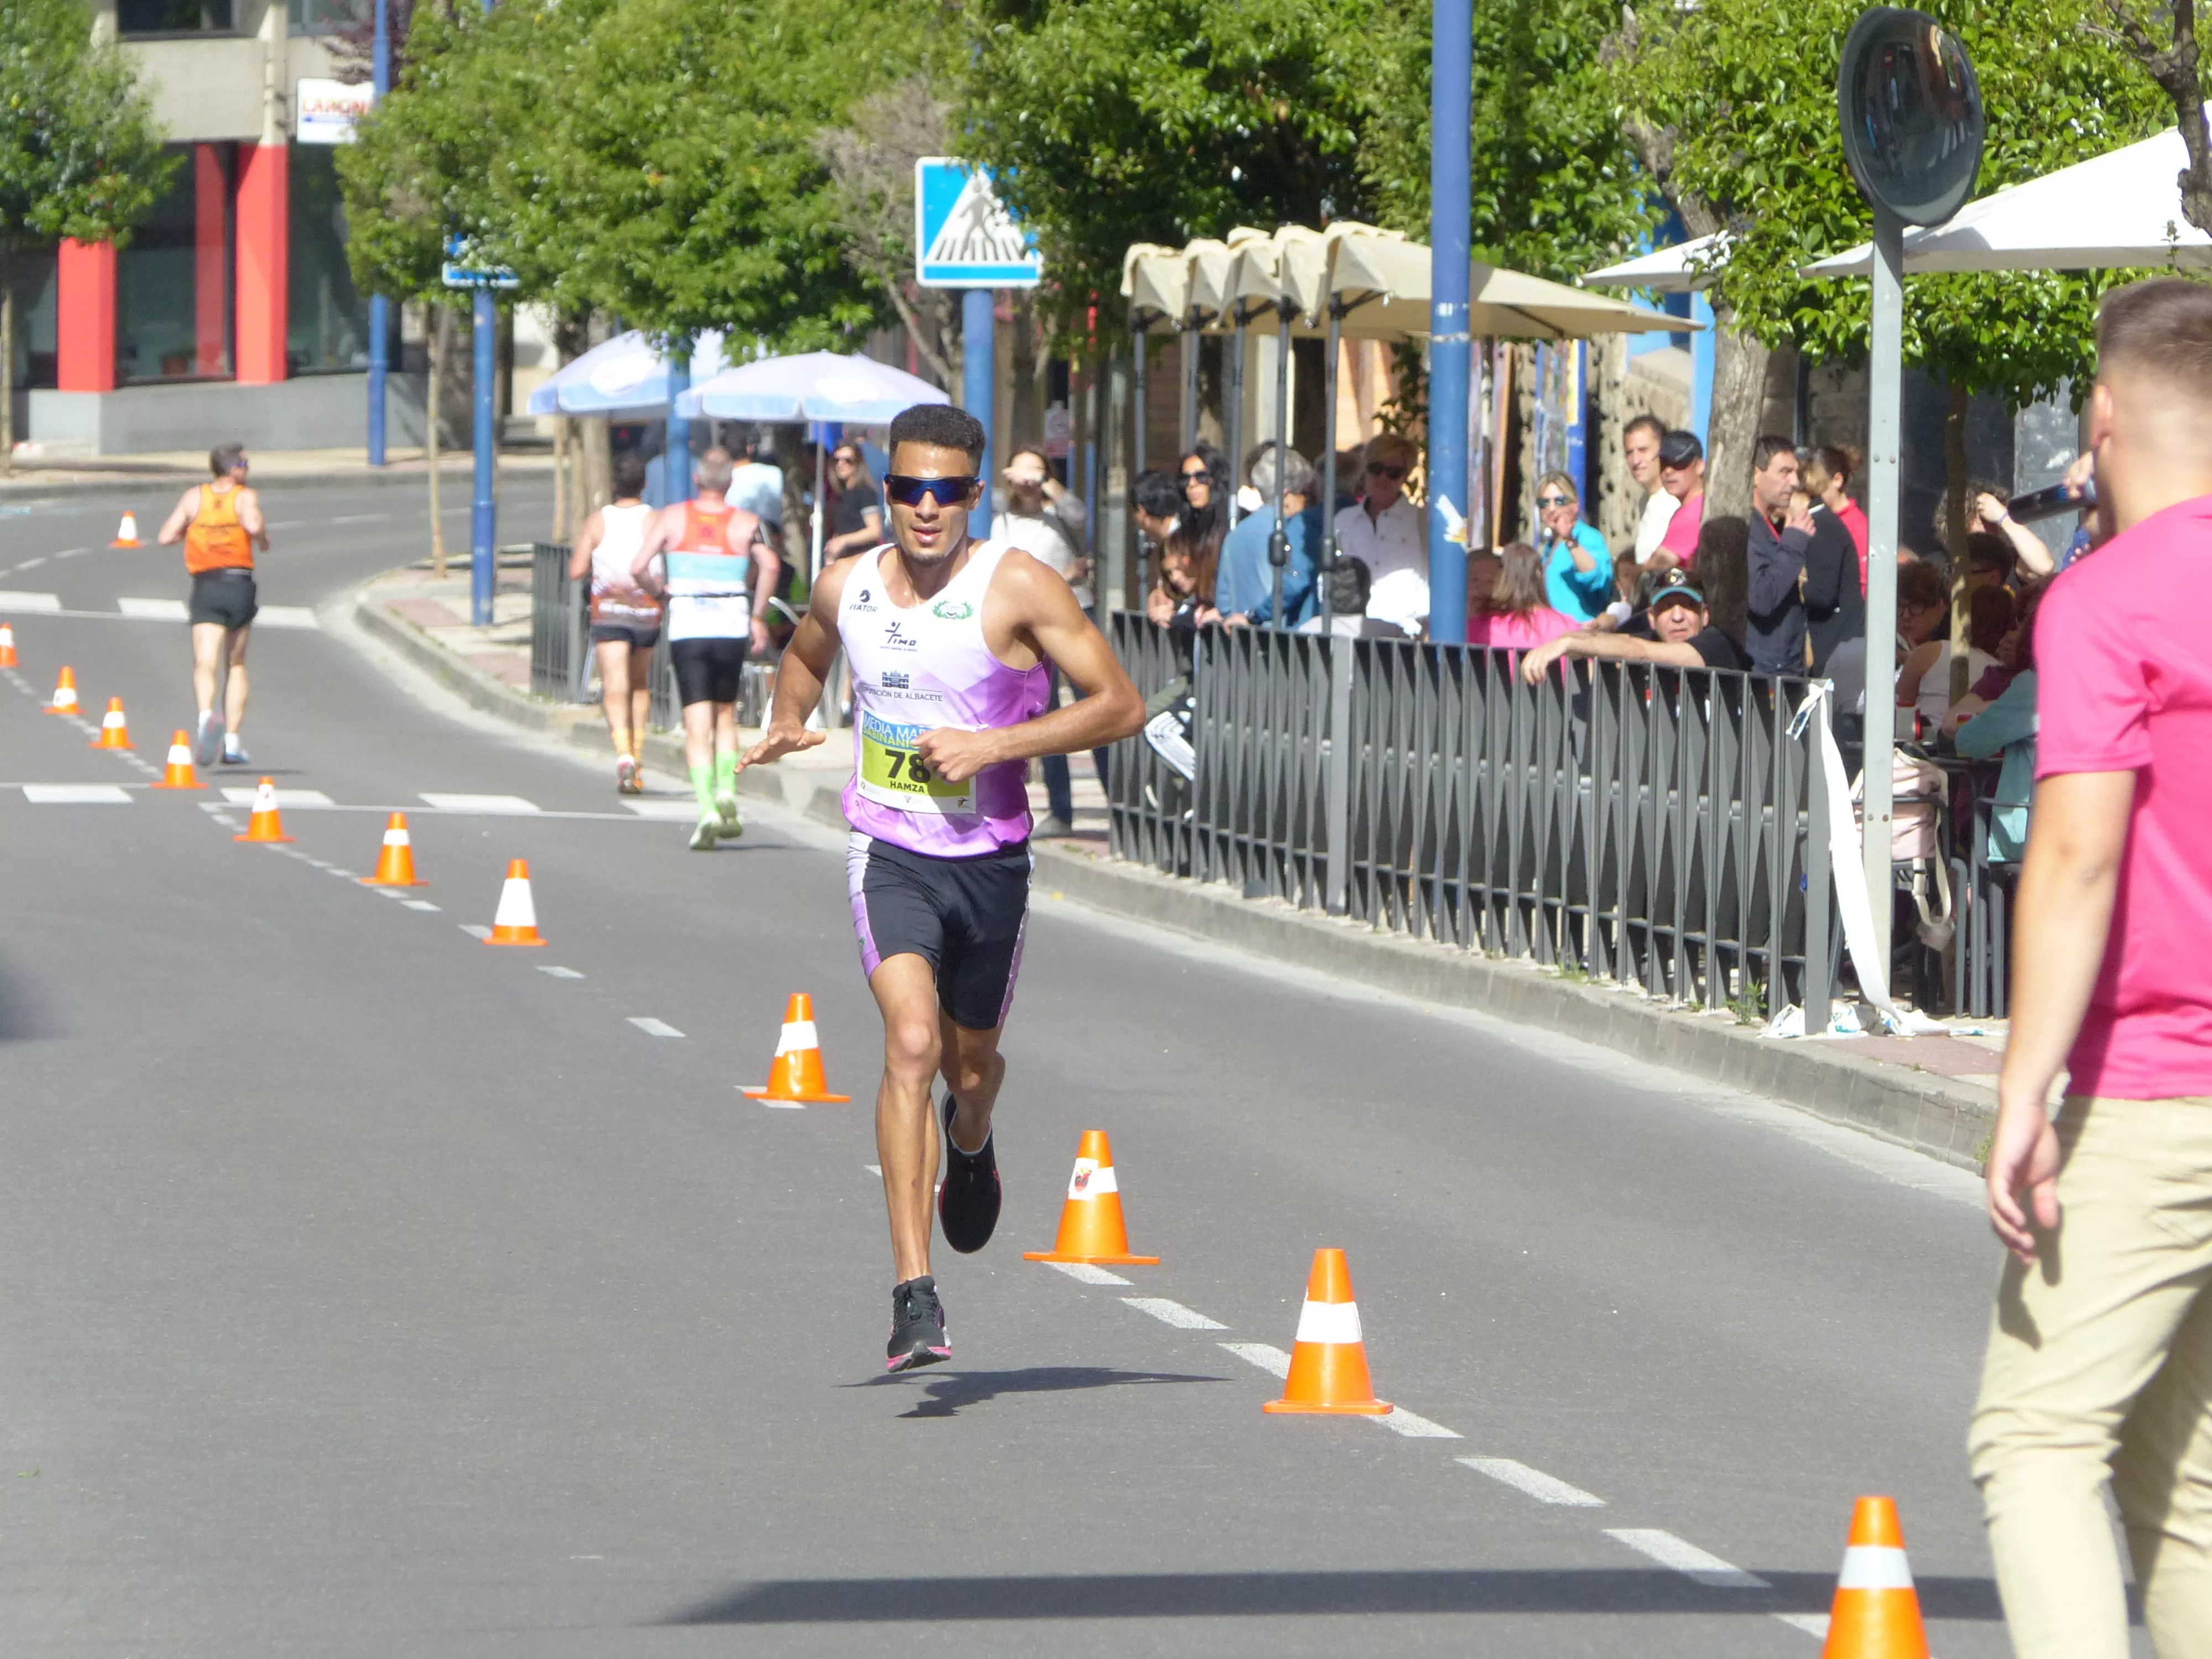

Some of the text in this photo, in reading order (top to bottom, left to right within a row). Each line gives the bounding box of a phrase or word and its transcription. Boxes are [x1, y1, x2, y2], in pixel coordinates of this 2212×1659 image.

[849, 604, 878, 613] VIATOR
[905, 692, 943, 702] ALBACETE
[864, 713, 894, 737] MEDIA
[885, 749, 931, 783] 78
[889, 780, 925, 794] HAMZA
